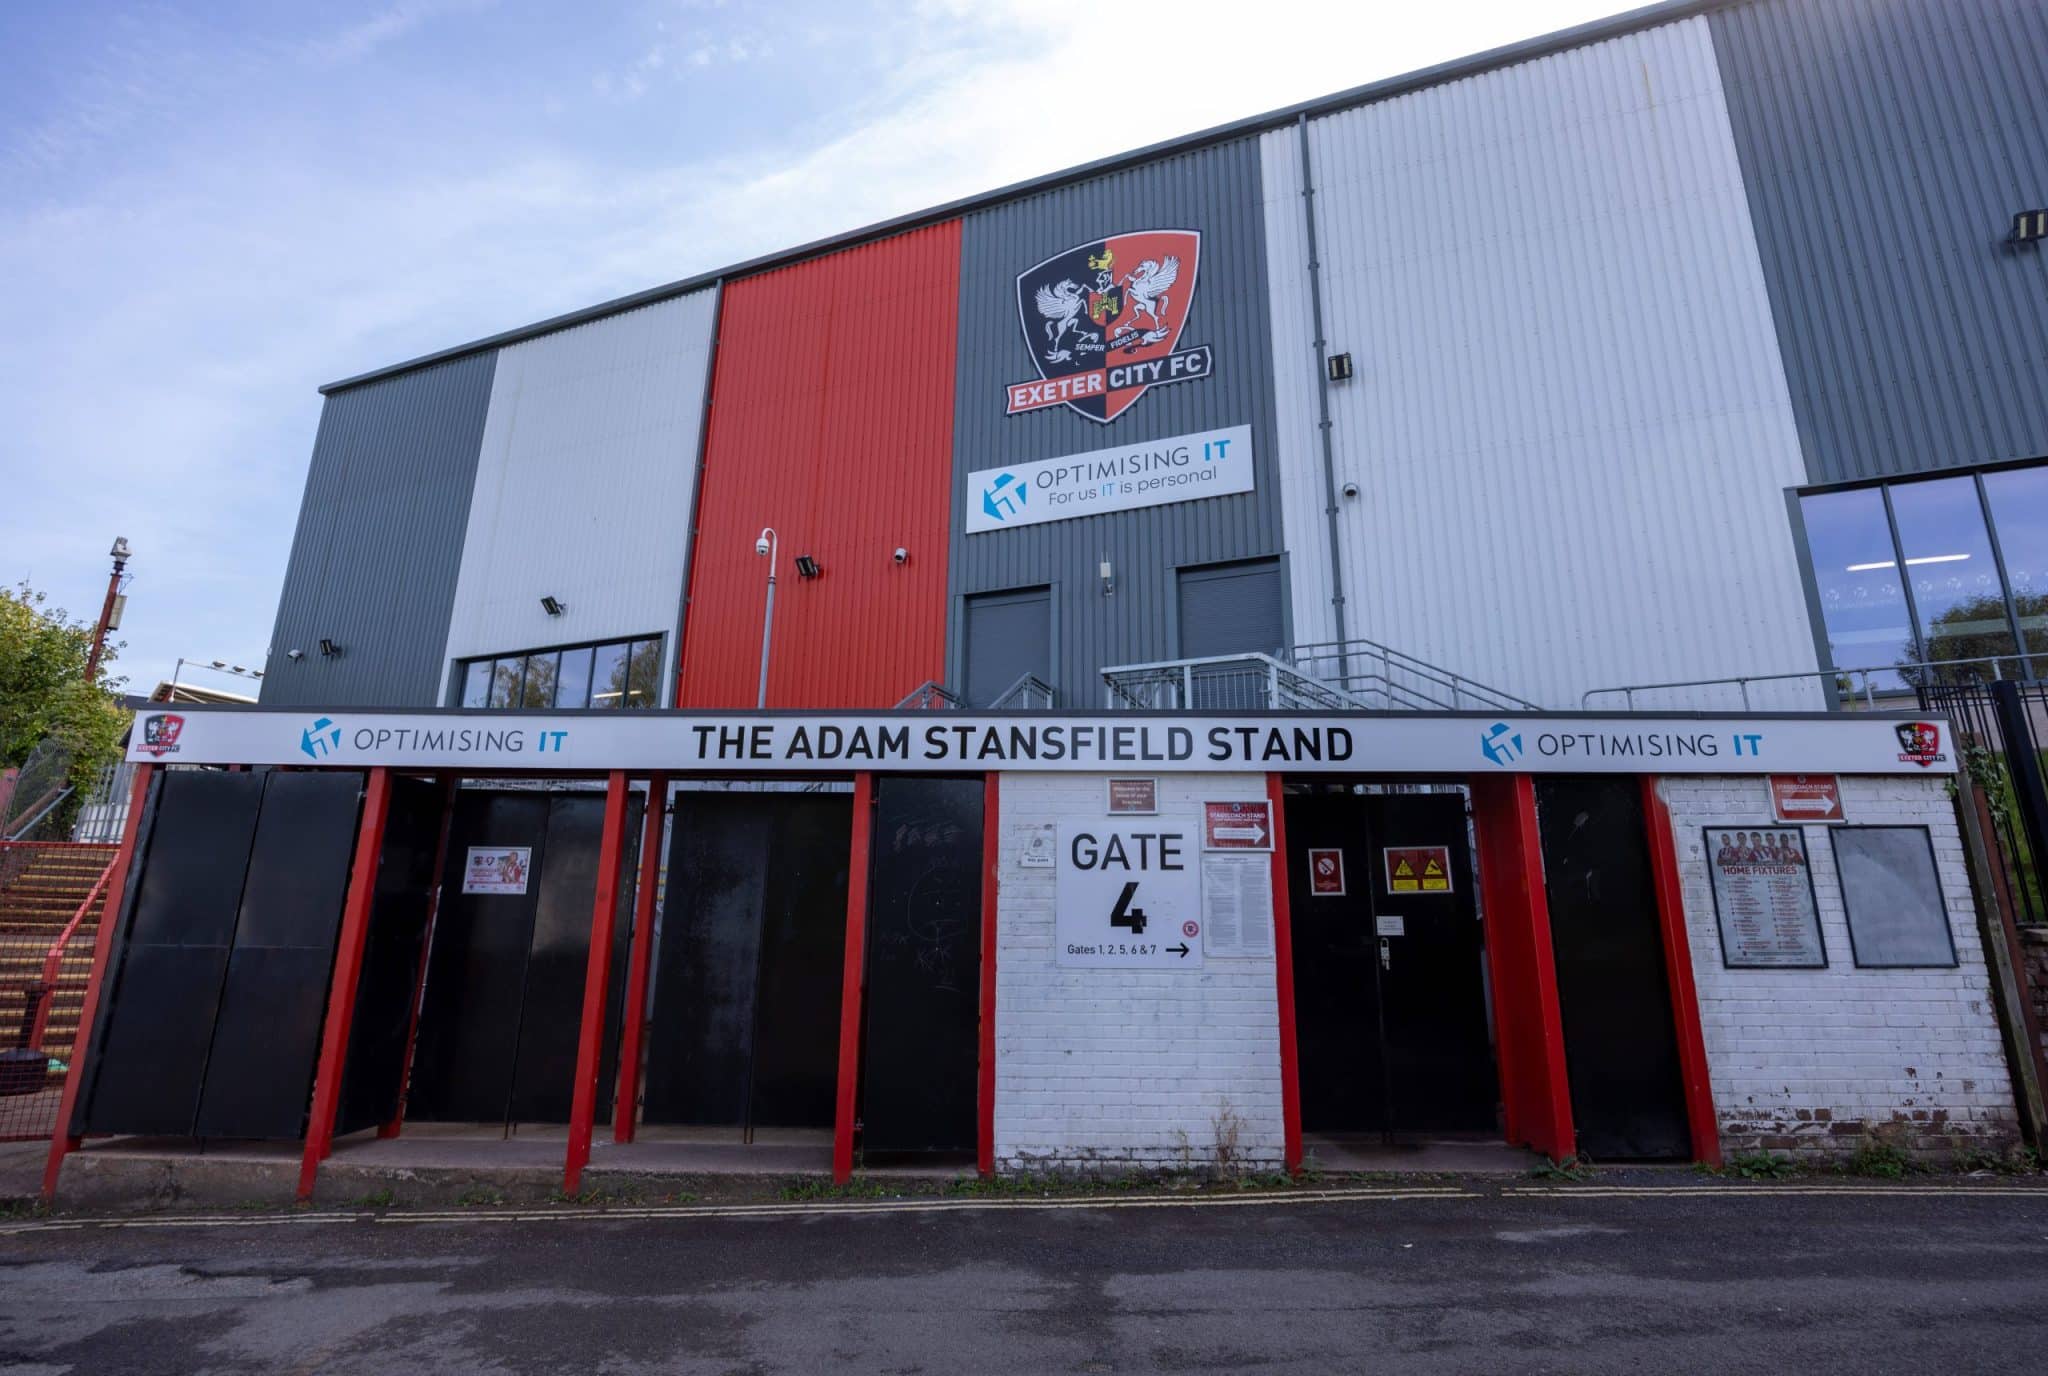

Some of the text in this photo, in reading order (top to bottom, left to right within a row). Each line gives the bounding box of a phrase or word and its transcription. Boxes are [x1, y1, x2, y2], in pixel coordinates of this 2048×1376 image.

[1075, 331, 1139, 352] SEMPER FIDELIS
[1014, 353, 1202, 407] EXETER CITY FC
[1036, 440, 1231, 489] OPTIMISING IT
[1049, 465, 1217, 505] For us IT is personal
[353, 728, 568, 753] OPTIMISING IT
[692, 725, 1353, 762] THE ADAM STANSFIELD STAND
[1537, 733, 1763, 757] OPTIMISING IT
[1071, 833, 1184, 871] GATE
[1723, 866, 1797, 875] HOME FIXTURES
[1110, 882, 1148, 934] 4
[1067, 944, 1096, 955] Gates
[1131, 944, 1137, 955] 6
[1140, 944, 1148, 955] &
[1150, 944, 1157, 955] 7
